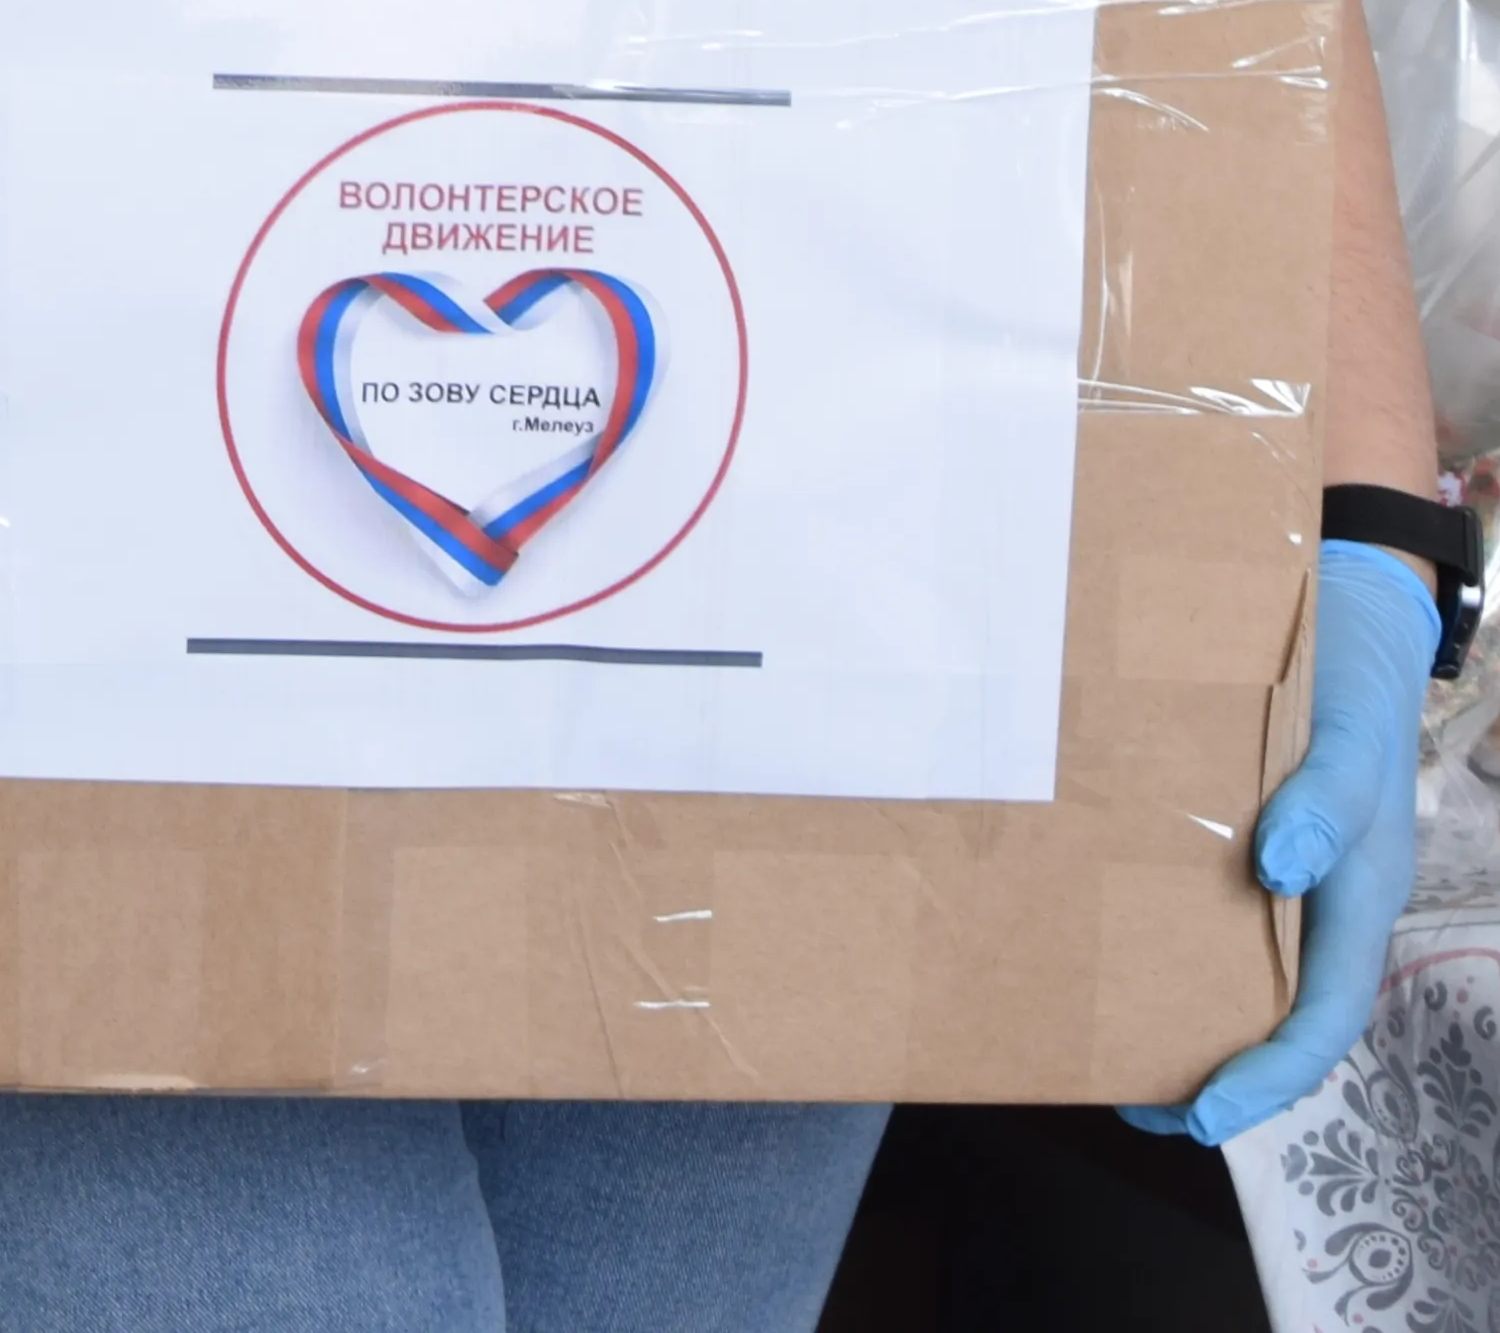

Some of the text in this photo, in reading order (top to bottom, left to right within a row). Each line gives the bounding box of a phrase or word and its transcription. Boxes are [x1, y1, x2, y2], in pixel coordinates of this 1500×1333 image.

[339, 181, 644, 217] ВОЛОНТЕРСКОЕ
[381, 222, 595, 256] ДВИЖЕНИЕ
[361, 382, 601, 411] ПО ЗОВУ СЕРДЦА
[512, 416, 594, 437] г.Мелеуз
